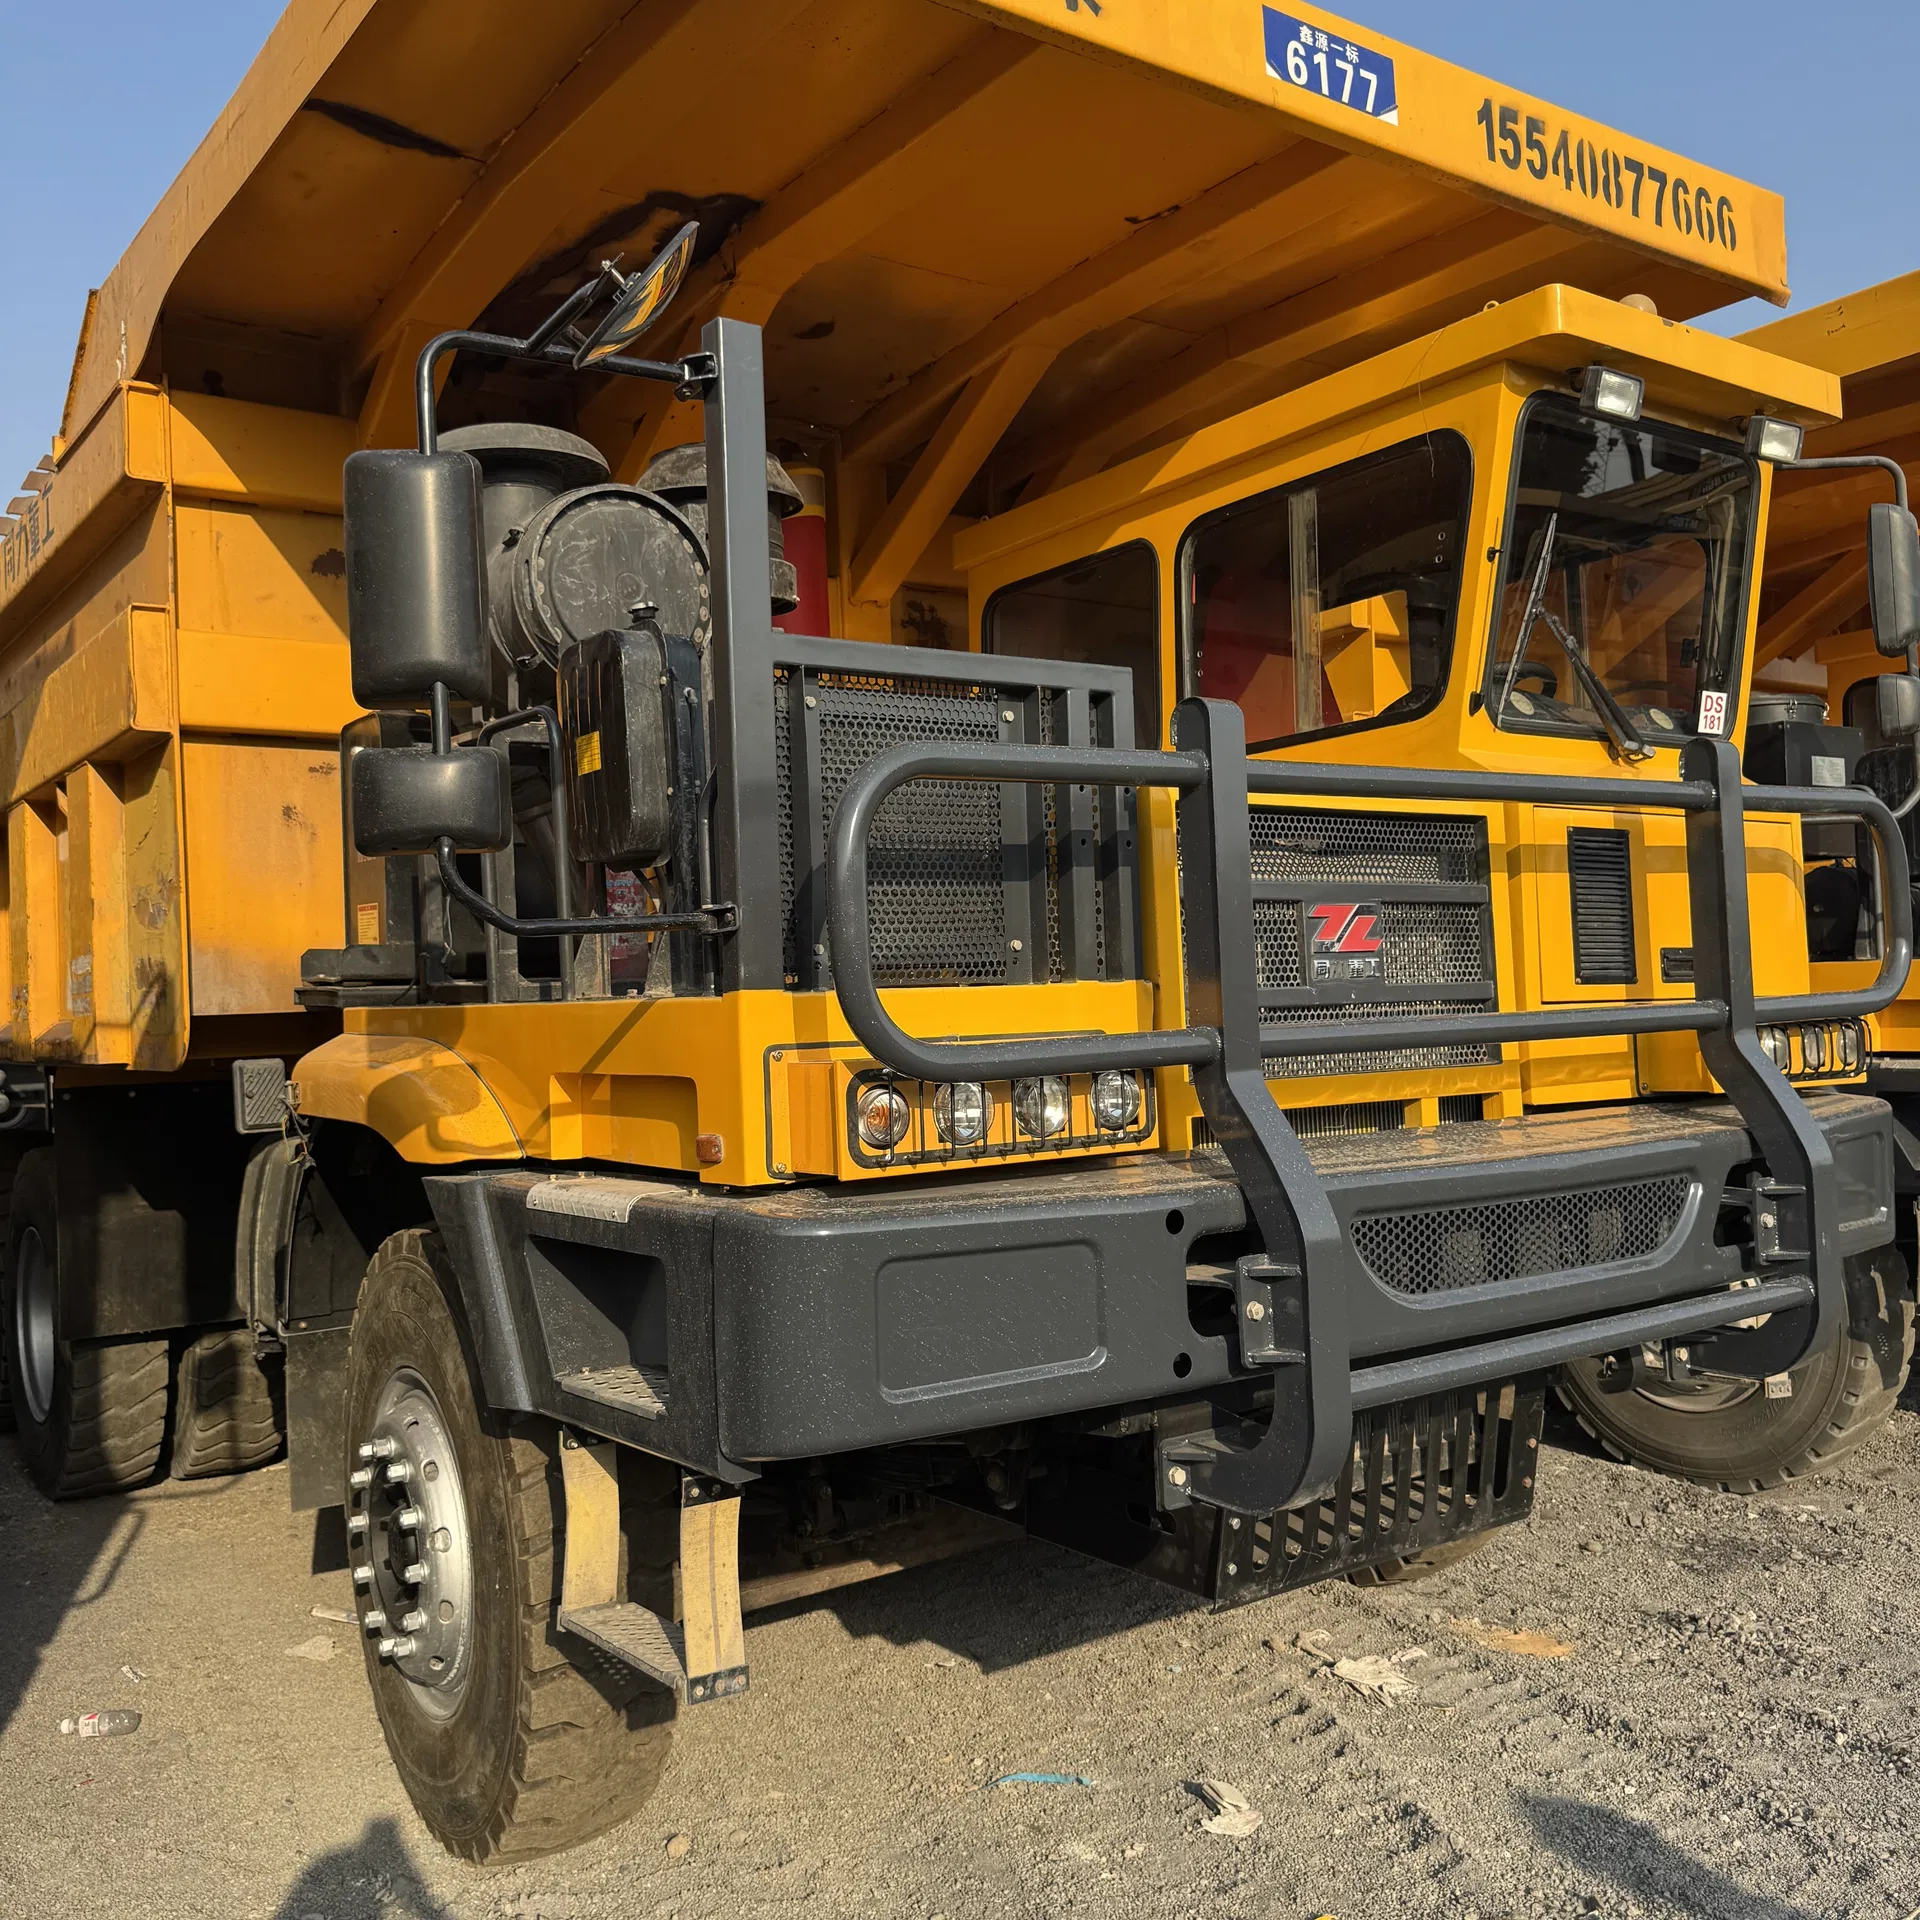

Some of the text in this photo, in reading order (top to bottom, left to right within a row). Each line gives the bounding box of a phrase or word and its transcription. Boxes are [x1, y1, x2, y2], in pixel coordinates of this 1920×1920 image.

[1299, 25, 1359, 64] 鑫源一标
[1286, 40, 1378, 114] 6177
[1477, 98, 1737, 252] 15540877666
[3, 482, 55, 590] 同力重工
[1703, 694, 1724, 714] DS
[1703, 714, 1721, 731] 181
